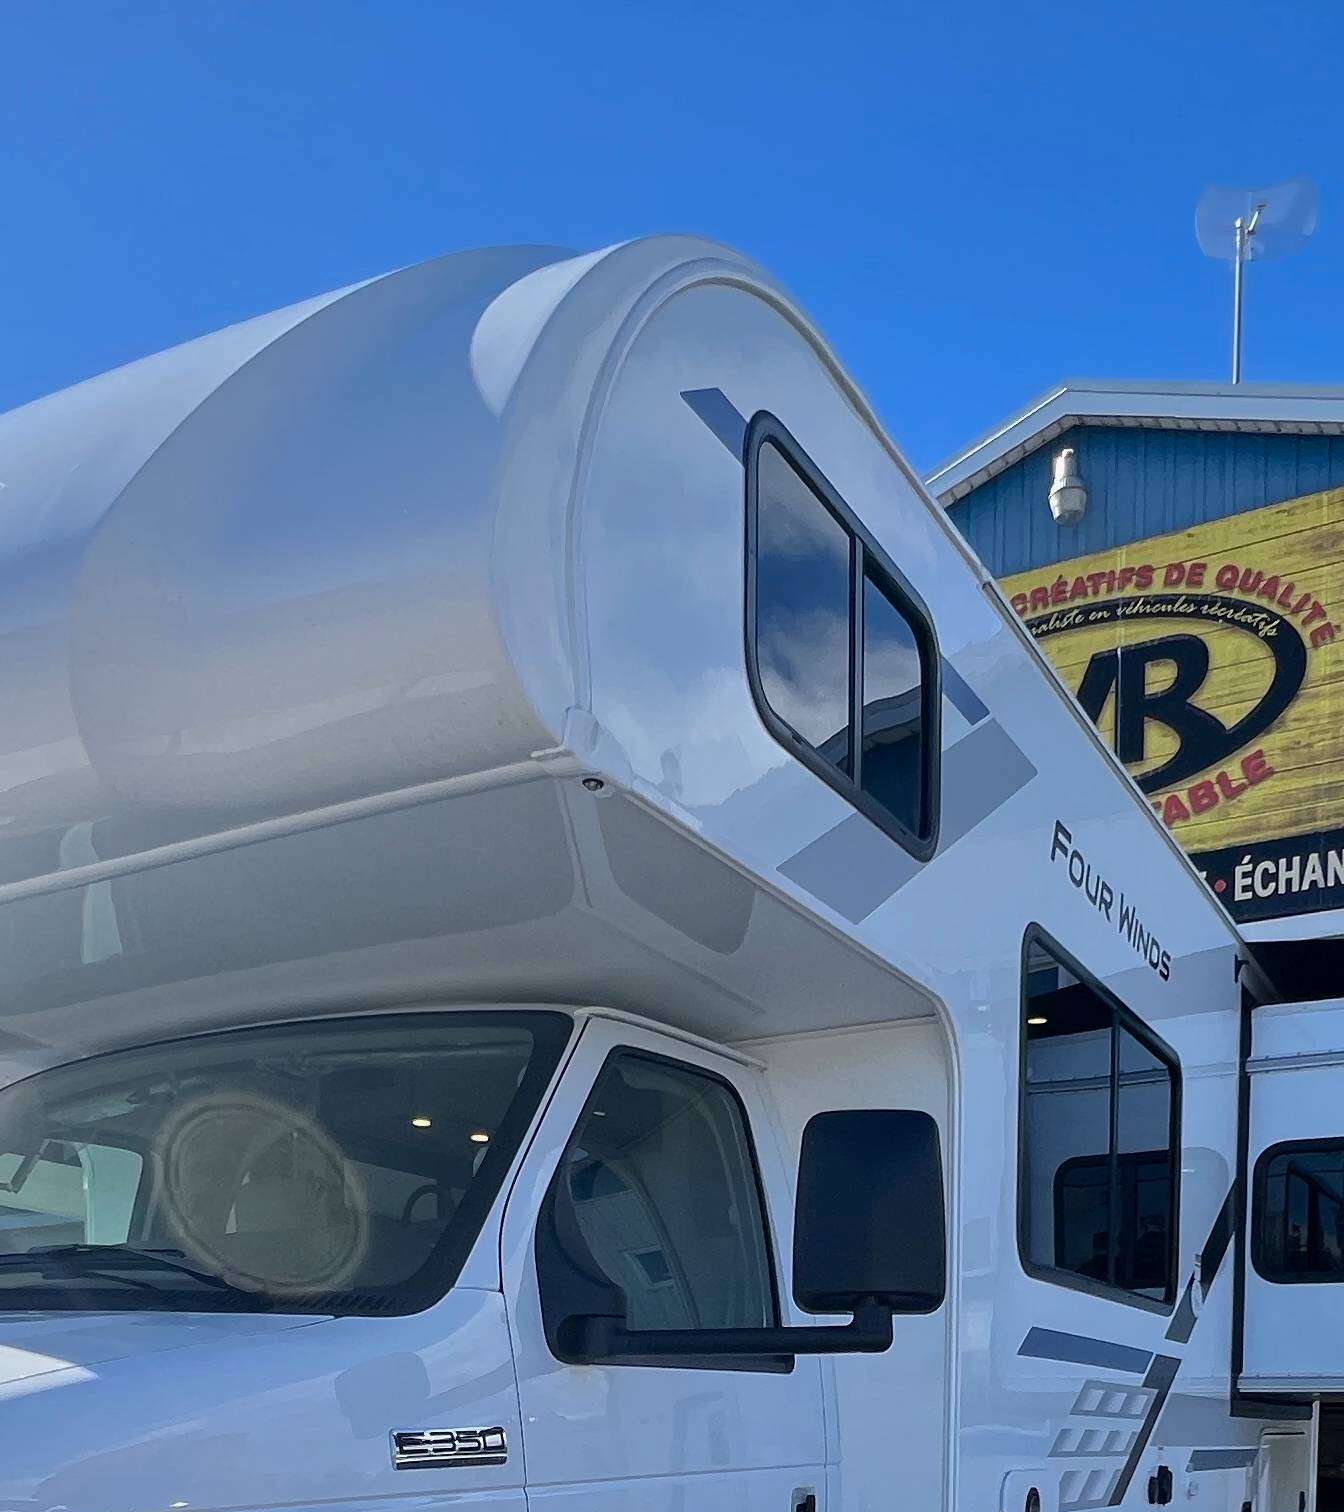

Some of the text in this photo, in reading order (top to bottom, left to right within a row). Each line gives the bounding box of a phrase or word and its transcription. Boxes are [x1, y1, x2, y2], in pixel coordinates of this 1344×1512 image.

[1089, 610, 1110, 621] en
[1116, 596, 1197, 616] véhicules
[1200, 601, 1280, 637] récréatifs
[1164, 563, 1207, 587] DE
[1215, 564, 1341, 648] QUALITÉ
[1152, 749, 1274, 830] ABLE
[1051, 820, 1171, 981] FOUR WINDS
